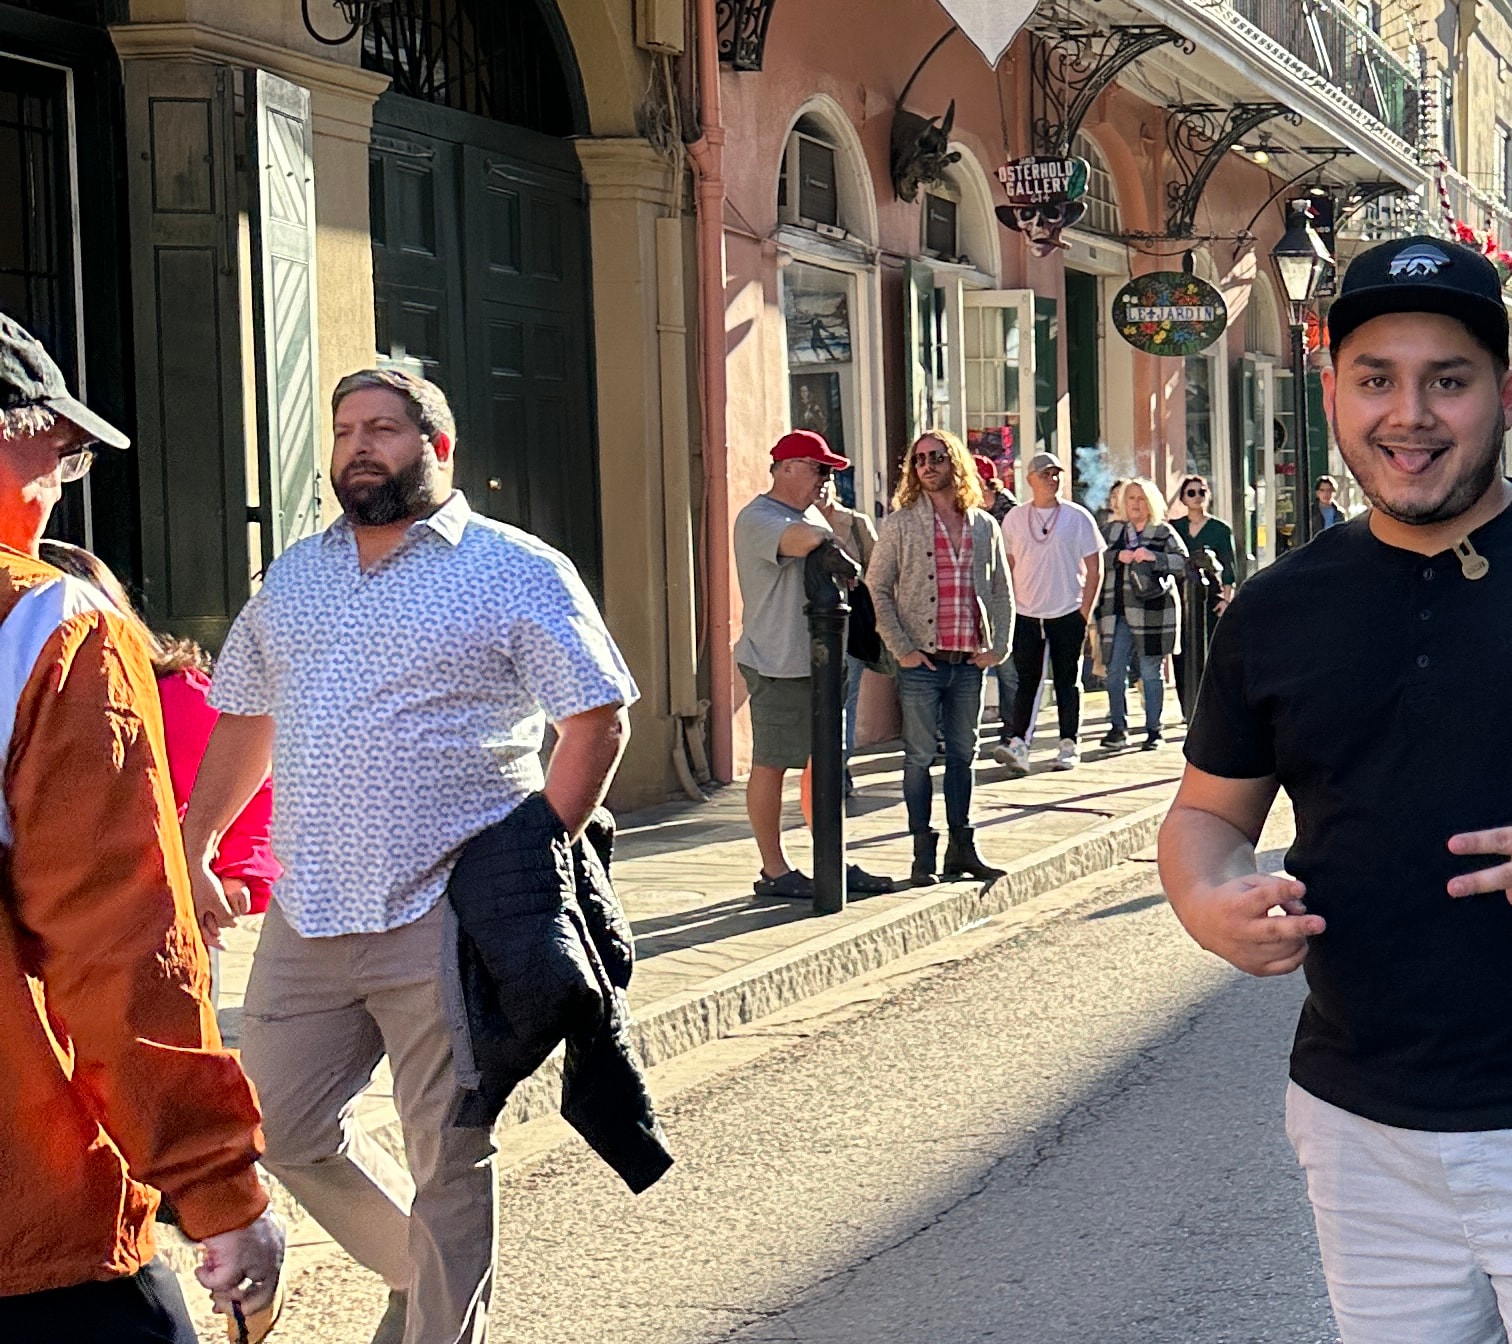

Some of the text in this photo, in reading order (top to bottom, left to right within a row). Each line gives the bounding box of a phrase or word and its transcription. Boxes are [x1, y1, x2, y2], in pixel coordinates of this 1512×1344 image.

[998, 160, 1074, 183] OSTERHOLD
[1006, 176, 1070, 196] GALLERY
[1127, 307, 1213, 320] LE JARDIN
